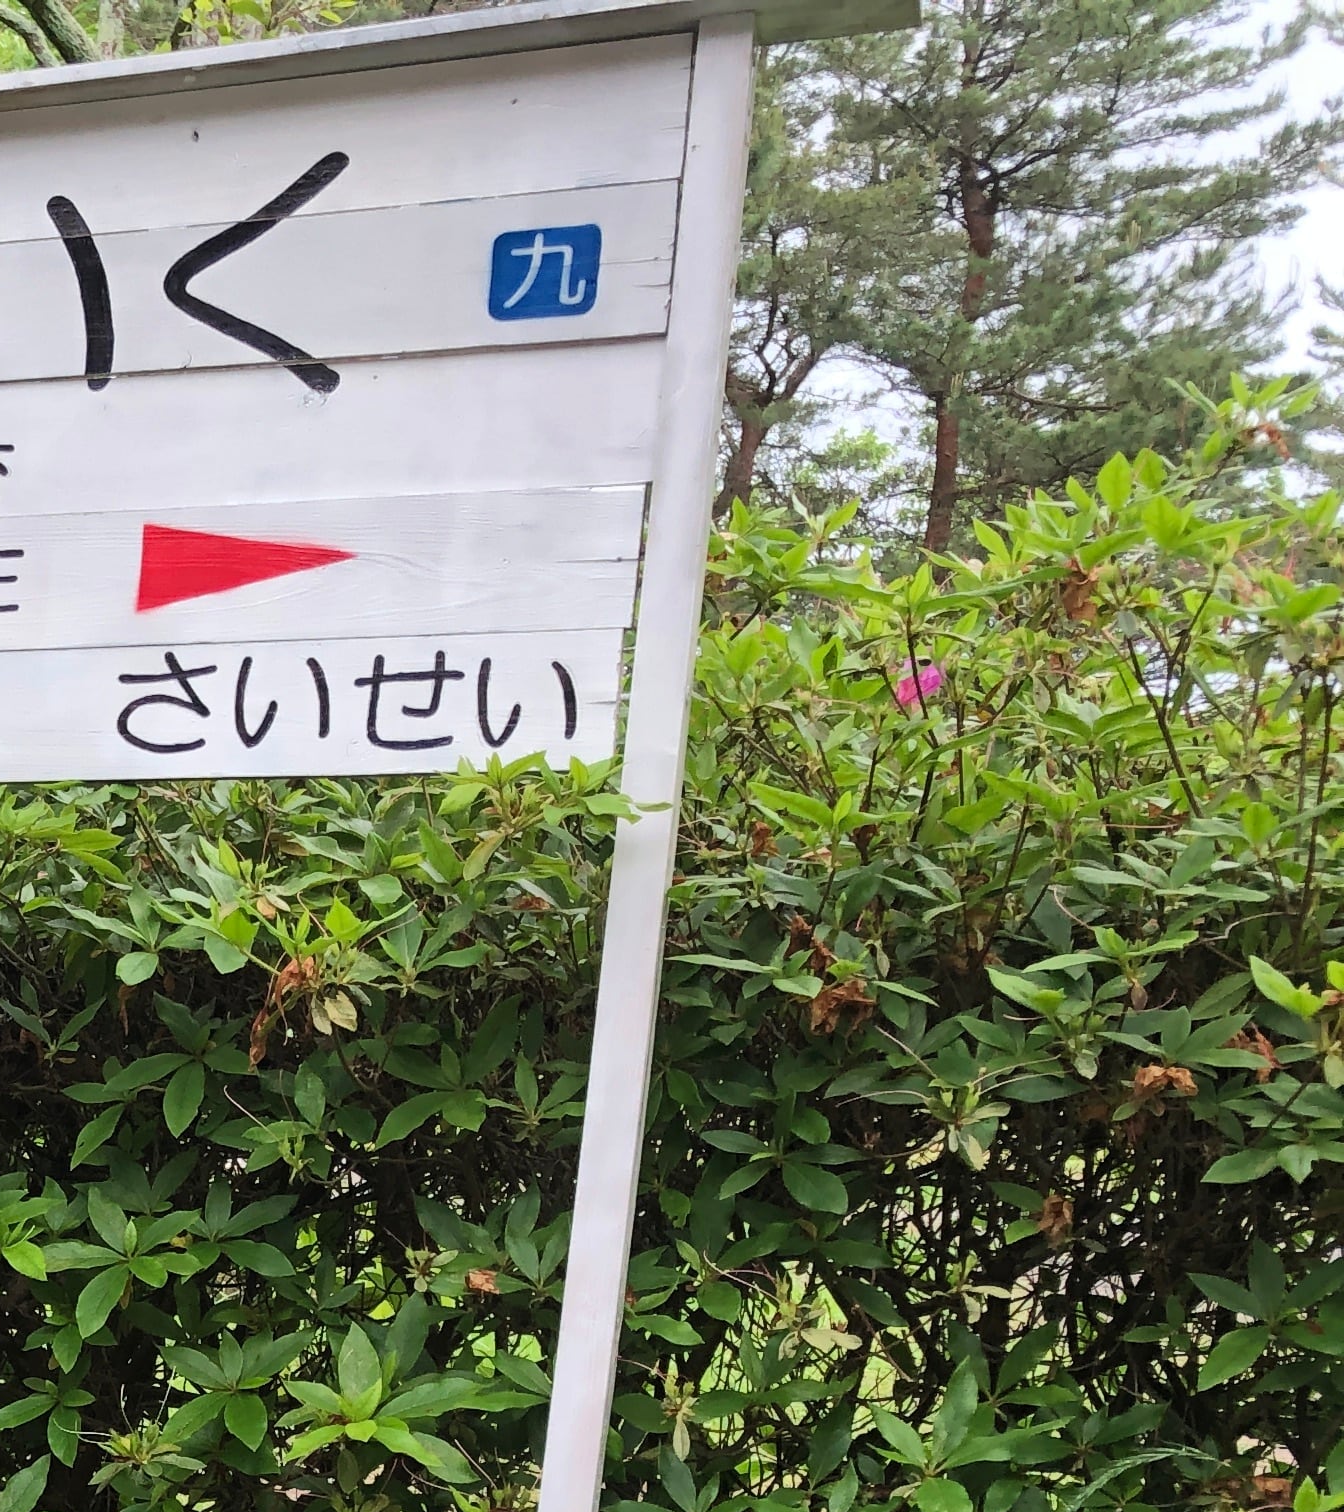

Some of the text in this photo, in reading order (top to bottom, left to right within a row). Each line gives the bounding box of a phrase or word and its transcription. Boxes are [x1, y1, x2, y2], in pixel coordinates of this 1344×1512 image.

[502, 232, 587, 309] 九
[116, 650, 578, 754] さいせい
